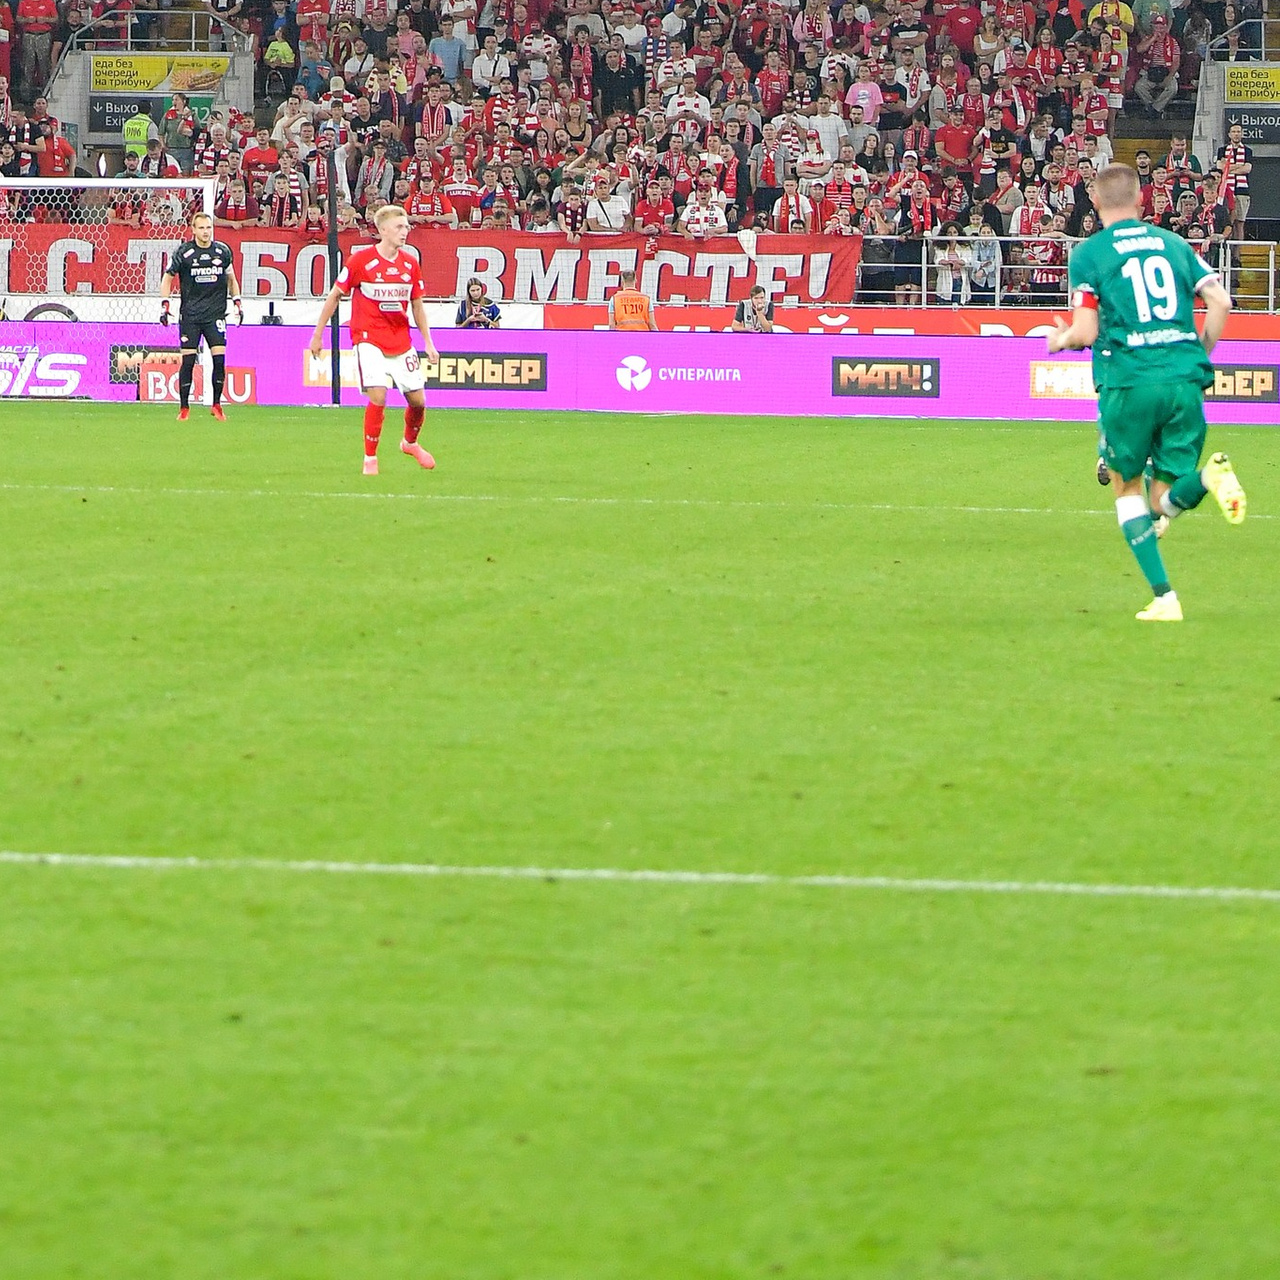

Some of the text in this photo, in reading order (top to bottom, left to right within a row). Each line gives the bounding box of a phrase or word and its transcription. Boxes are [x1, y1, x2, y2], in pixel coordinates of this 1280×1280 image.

[95, 58, 133, 70] еда без
[95, 69, 139, 78] очереди
[1229, 69, 1269, 80] еда без
[95, 77, 151, 88] на трибуну
[1229, 80, 1275, 89] очереди
[105, 102, 139, 113] Выхо
[105, 116, 126, 126] Exit
[1241, 128, 1264, 139] Exit
[46, 239, 96, 295] С
[455, 246, 834, 303] ВМЕСТЕ!
[190, 265, 223, 277] ЛУКОЙЛ
[1121, 255, 1178, 324] 19
[622, 303, 644, 315] T219
[421, 357, 543, 386] РЕМЬЕР
[658, 363, 933, 392] СУПЕРЛИГА МАТЧ!
